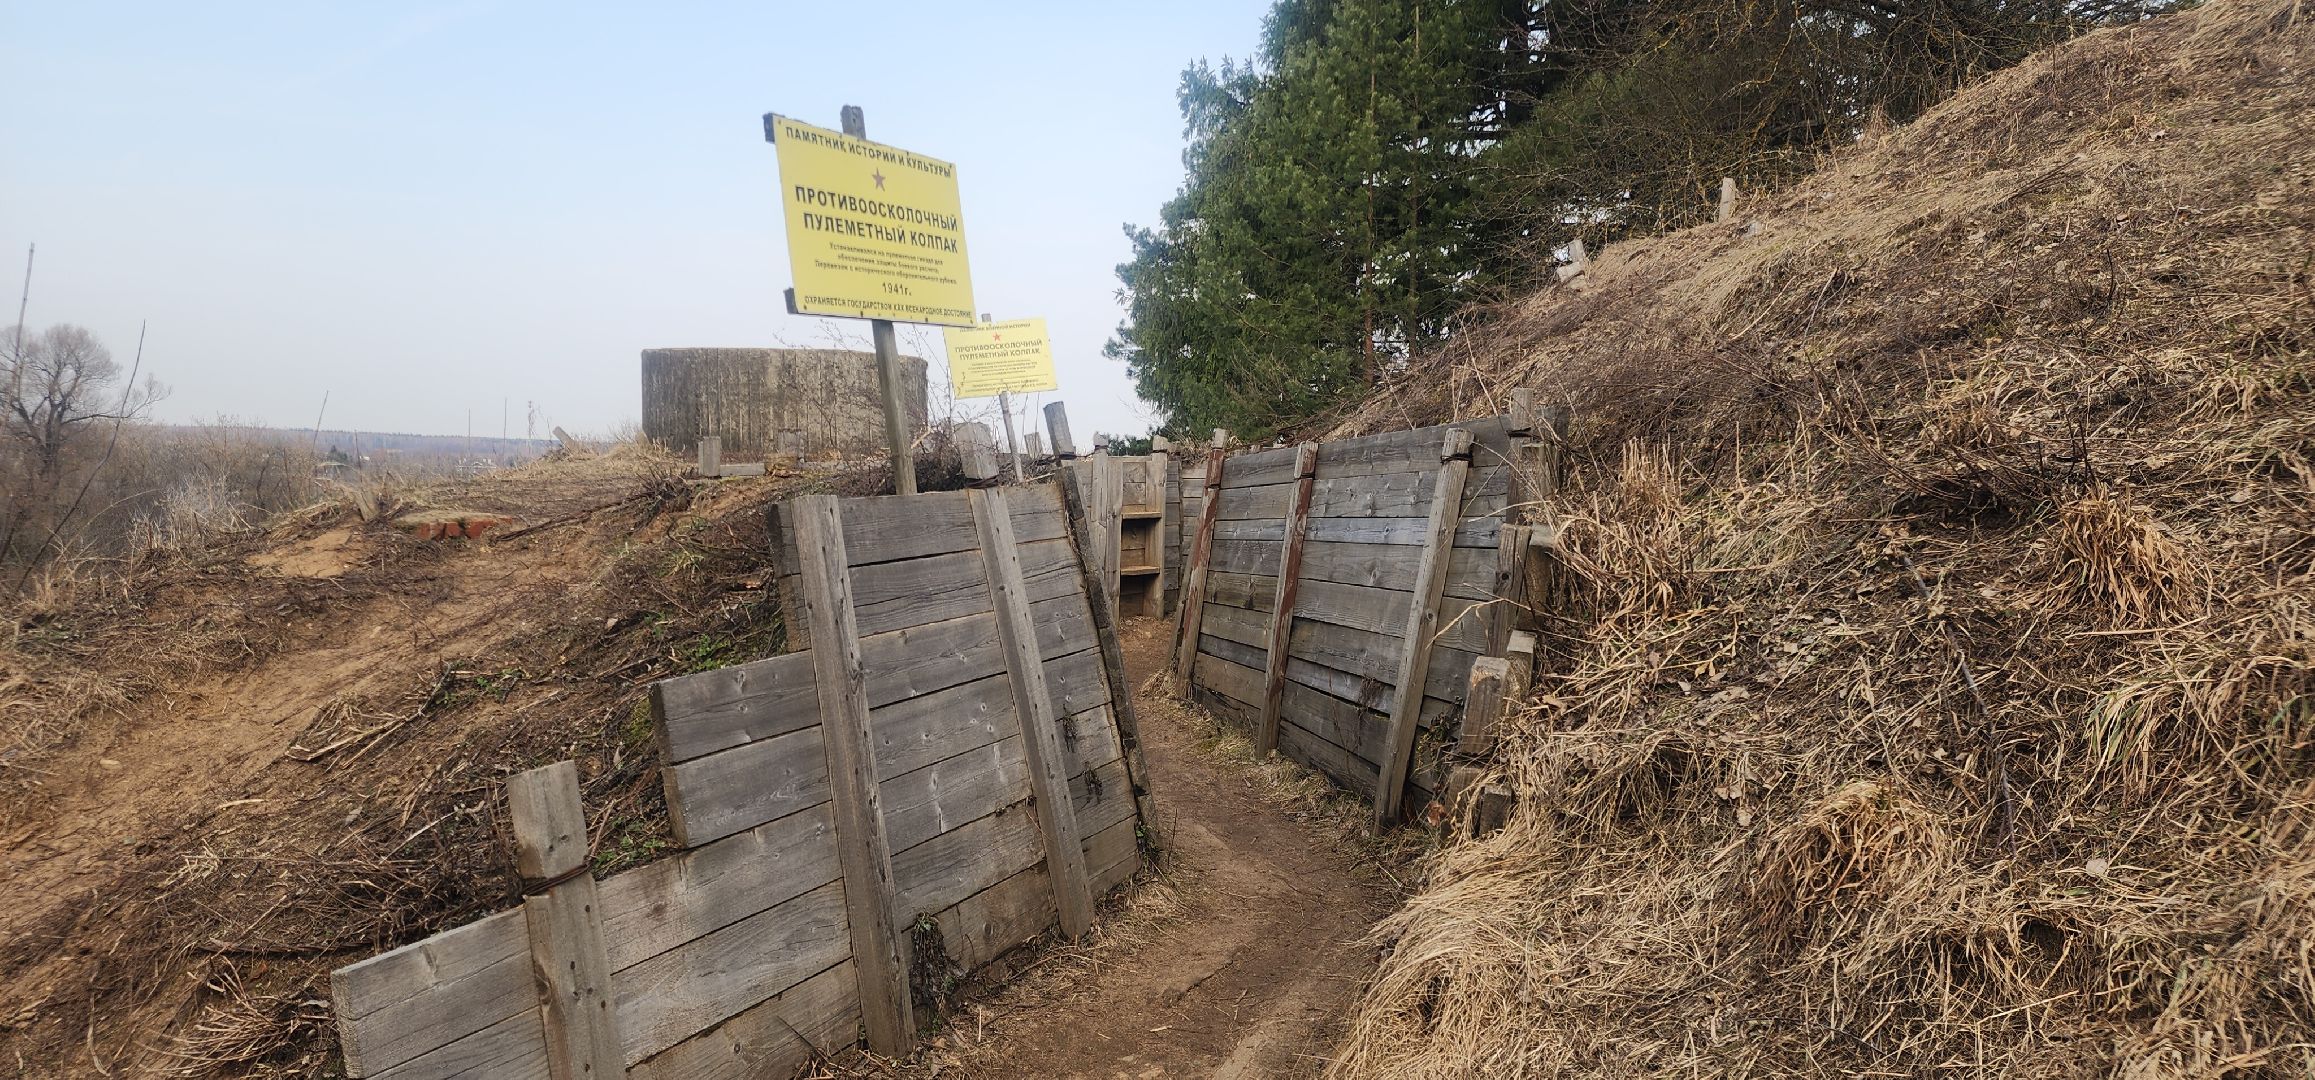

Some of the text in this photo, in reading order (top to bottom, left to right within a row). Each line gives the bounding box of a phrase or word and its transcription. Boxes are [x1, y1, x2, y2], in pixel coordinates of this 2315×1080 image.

[785, 126, 952, 178] ПАМЯТНИК ИСТОРИИ И КУЛЬТУРЫ
[795, 185, 958, 232] ПРОТИВООСКОЛОЧНЫЙ
[803, 211, 958, 253] ПУЛЕМЕТНЫЙ КОЛПАК
[883, 282, 912, 296] 1941г.
[804, 295, 846, 307] ОХРАНЯЕТСЯ
[847, 299, 892, 311] ГОСУДАРСТВОМ
[893, 303, 905, 311] КАК
[905, 304, 943, 316] ВСЕНАРОДНОЕ
[955, 339, 1042, 353] ПРОТИВООСКОЛОЧНЫЙ
[959, 347, 1041, 361] ПУЛЕМЕТНЫЙ КОЛПАК
